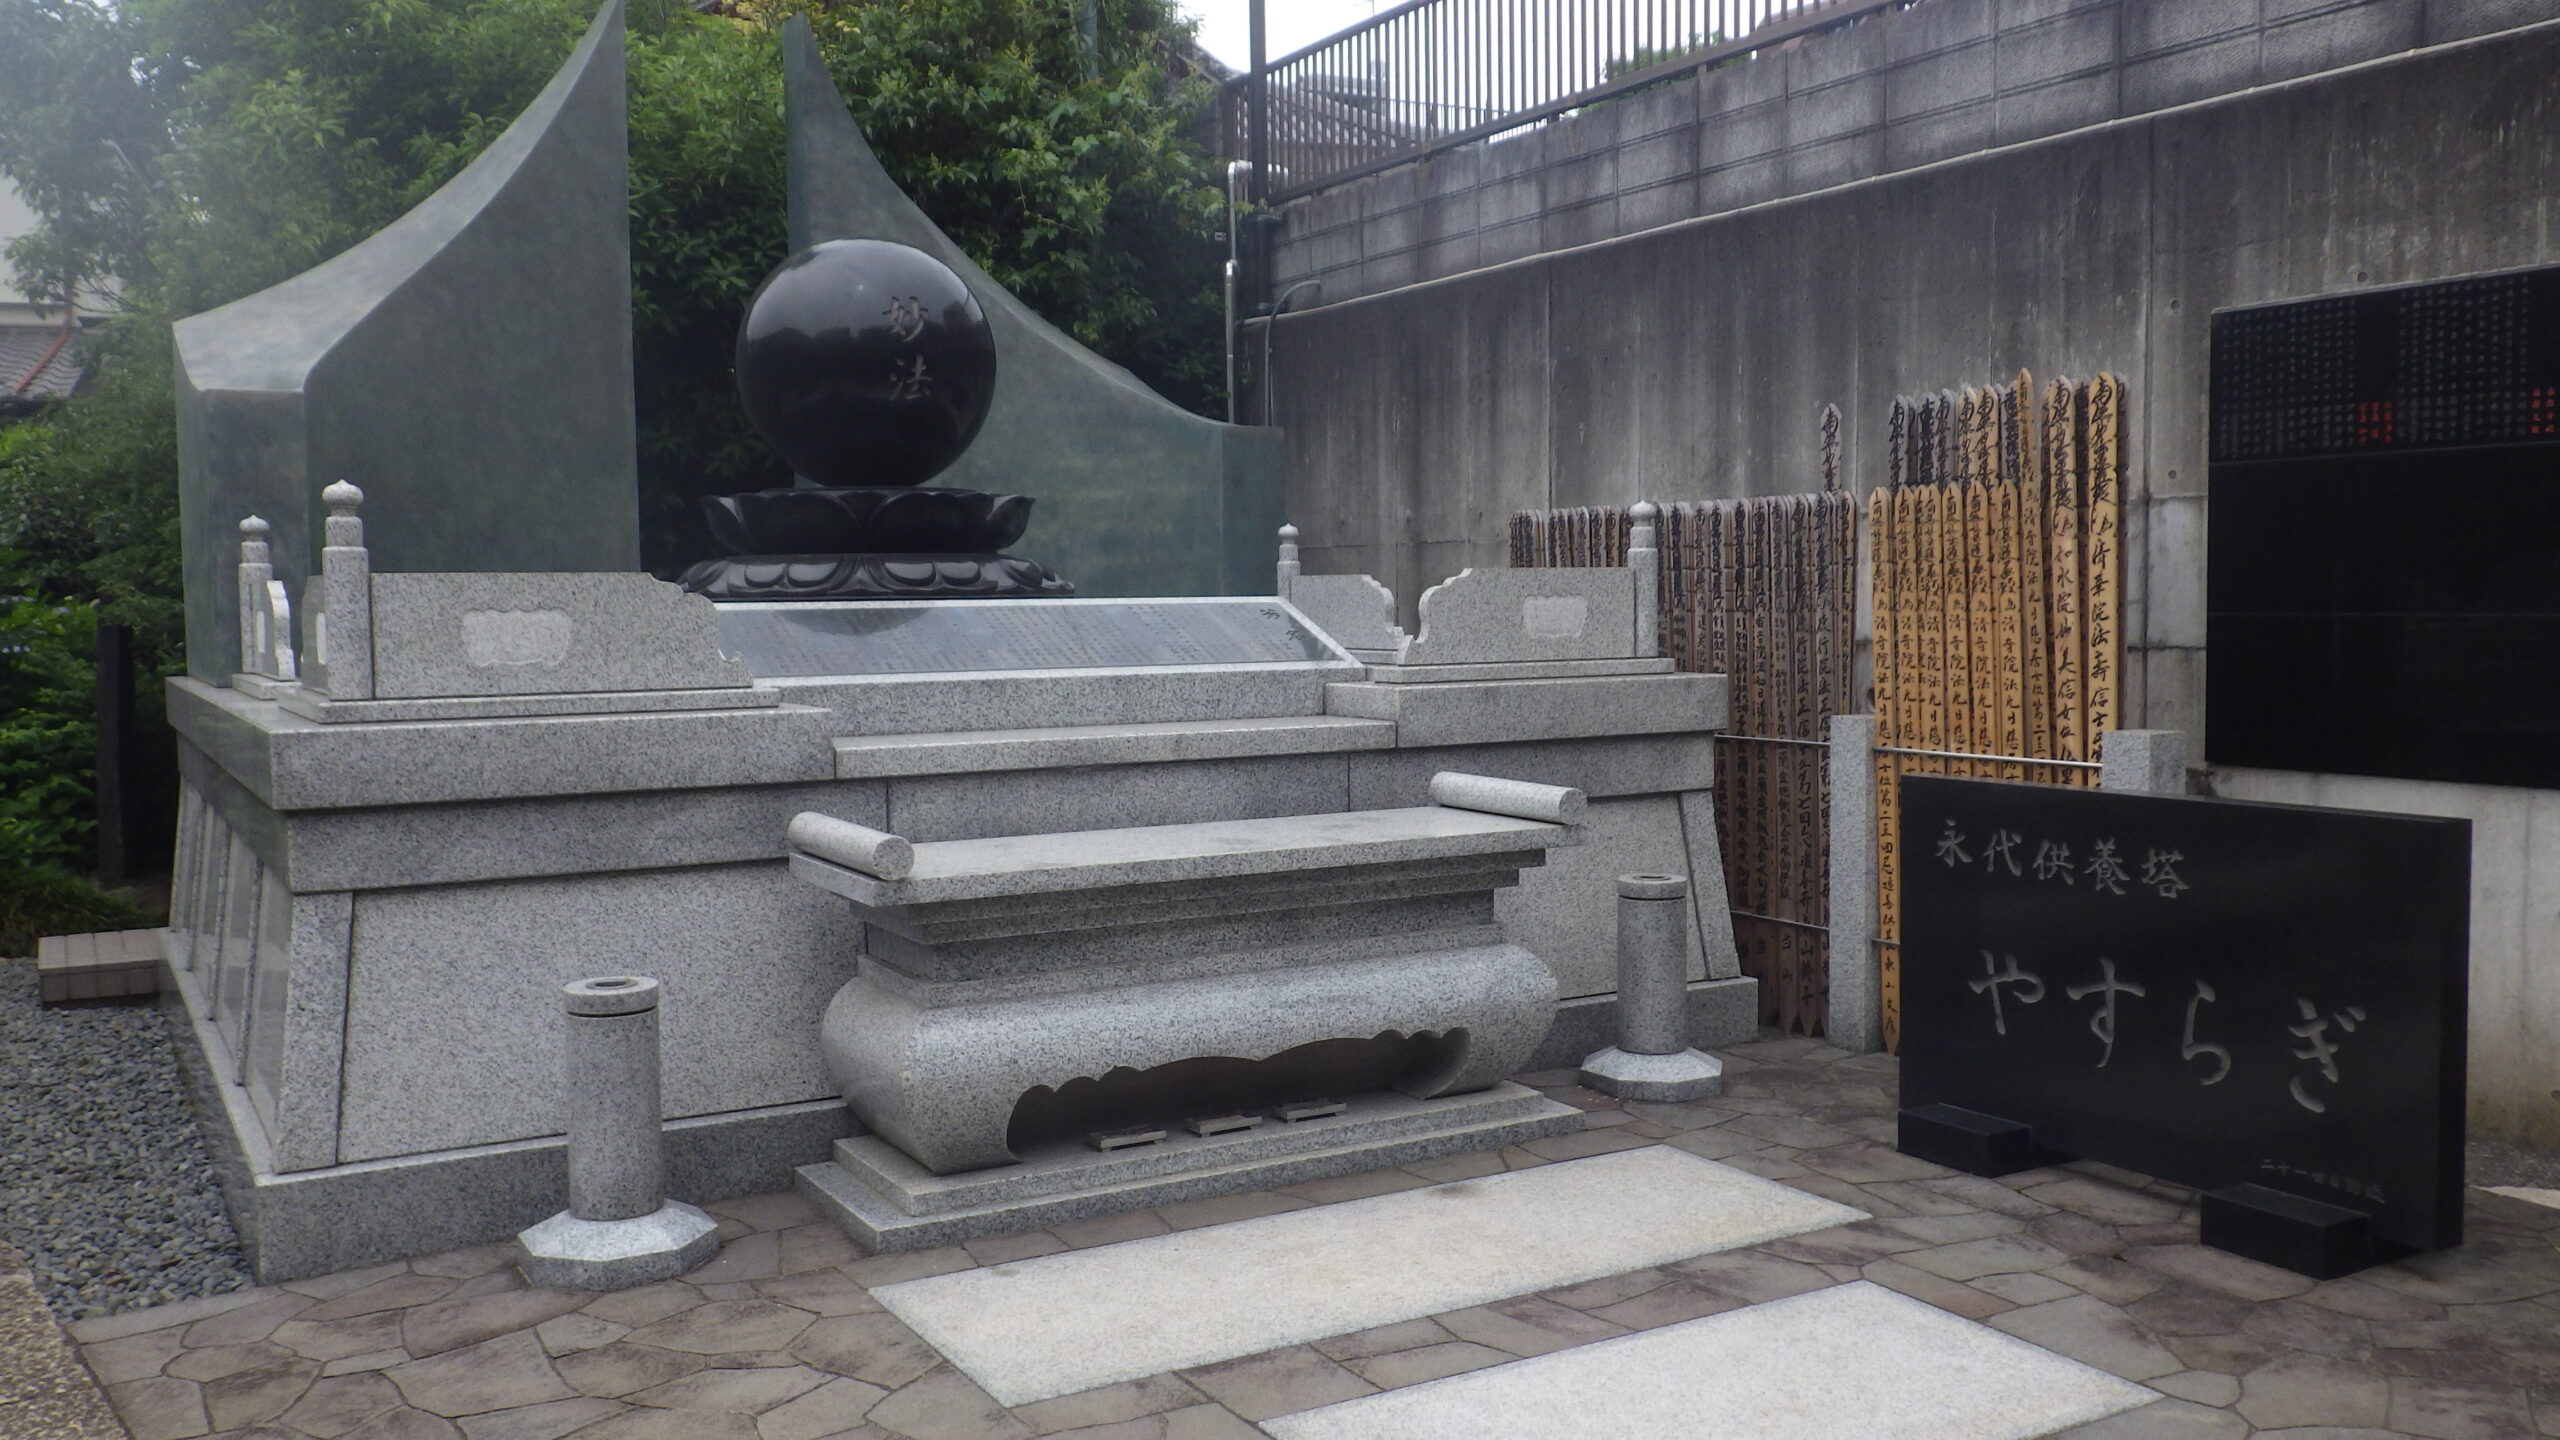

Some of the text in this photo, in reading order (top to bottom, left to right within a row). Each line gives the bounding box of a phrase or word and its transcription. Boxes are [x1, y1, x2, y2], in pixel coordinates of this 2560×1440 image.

[882, 295, 933, 401] 妙法
[1934, 817, 2192, 900] 永代供養塔
[1967, 948, 2368, 1115] やすらぎ
